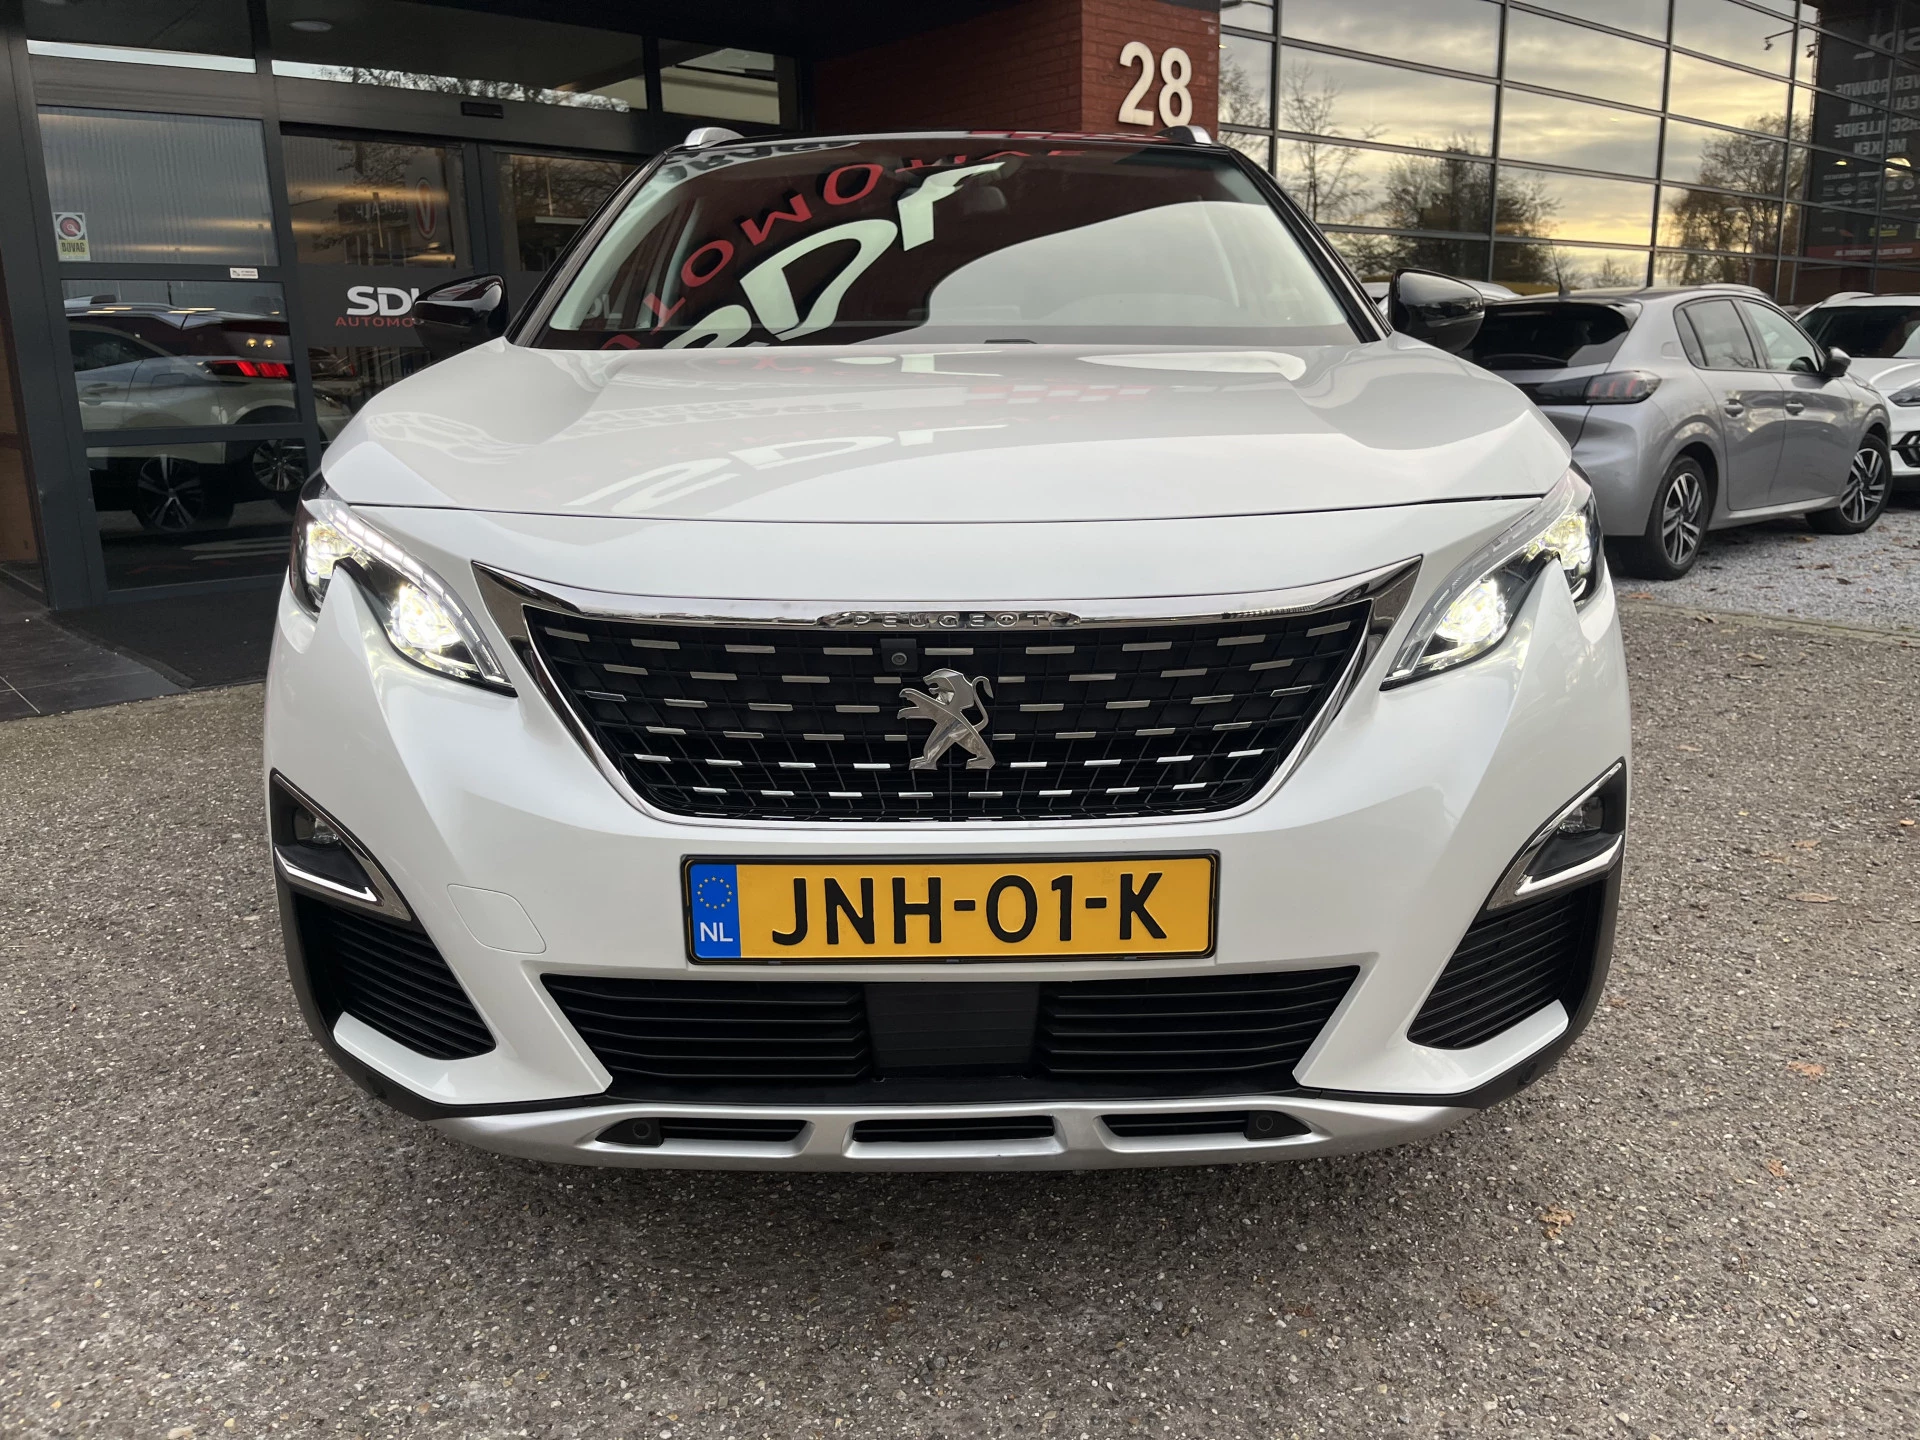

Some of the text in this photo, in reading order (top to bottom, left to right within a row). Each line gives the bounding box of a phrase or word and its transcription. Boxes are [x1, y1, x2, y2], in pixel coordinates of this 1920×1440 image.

[1118, 41, 1192, 127] 28
[61, 242, 85, 252] BOVAG
[335, 316, 414, 327] AUTOMO
[853, 611, 1044, 628] PEUGEOT
[771, 872, 1168, 946] JNH-01-K
[700, 921, 734, 943] NL
